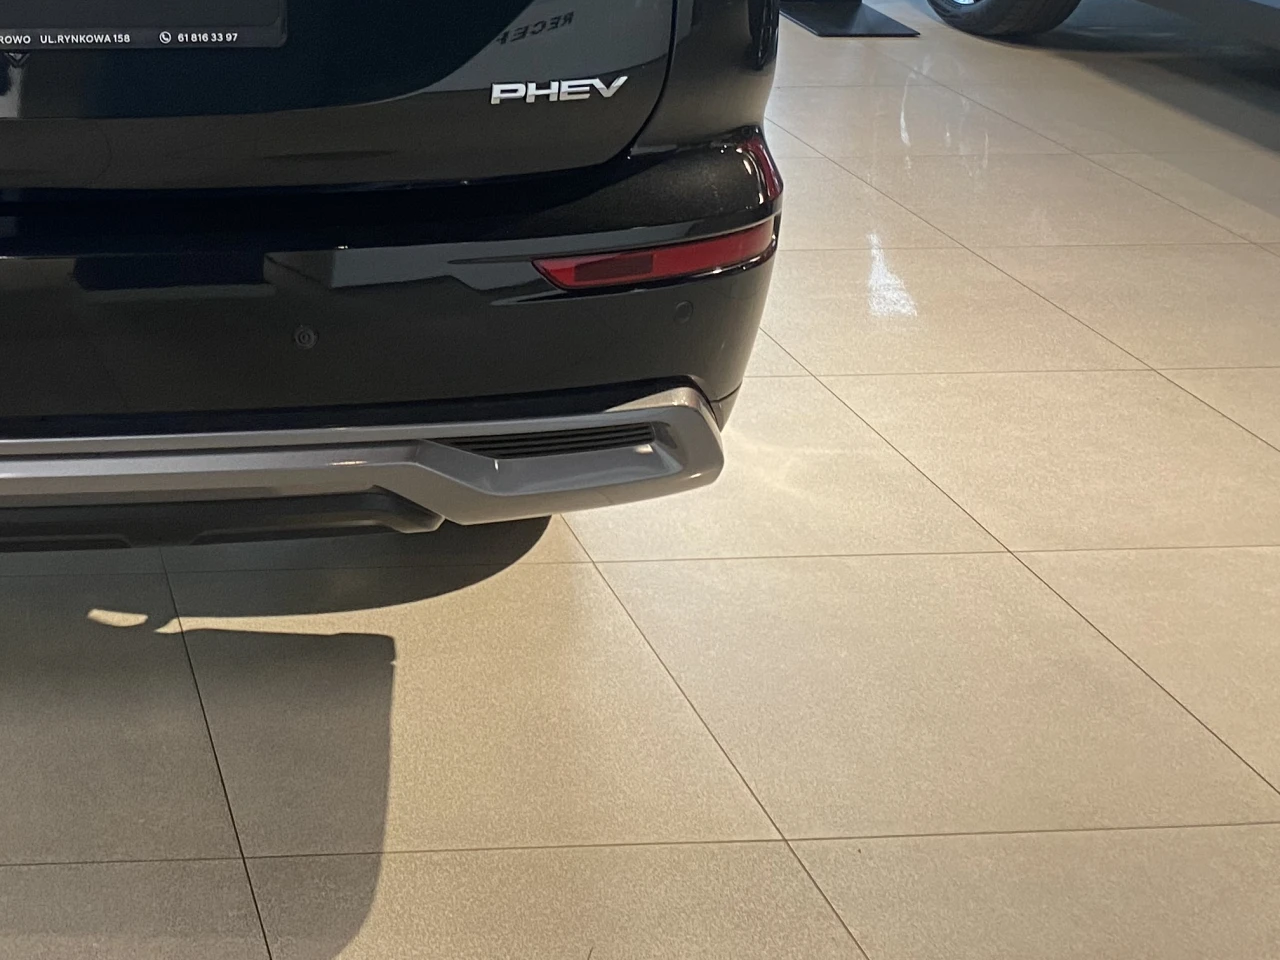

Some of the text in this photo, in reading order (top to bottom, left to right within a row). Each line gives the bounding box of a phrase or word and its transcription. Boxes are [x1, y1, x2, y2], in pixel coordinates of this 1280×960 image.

[113, 33, 131, 44] 158
[191, 33, 208, 43] 816
[211, 33, 223, 43] 33
[226, 33, 238, 43] 97
[490, 75, 629, 105] PHEV
